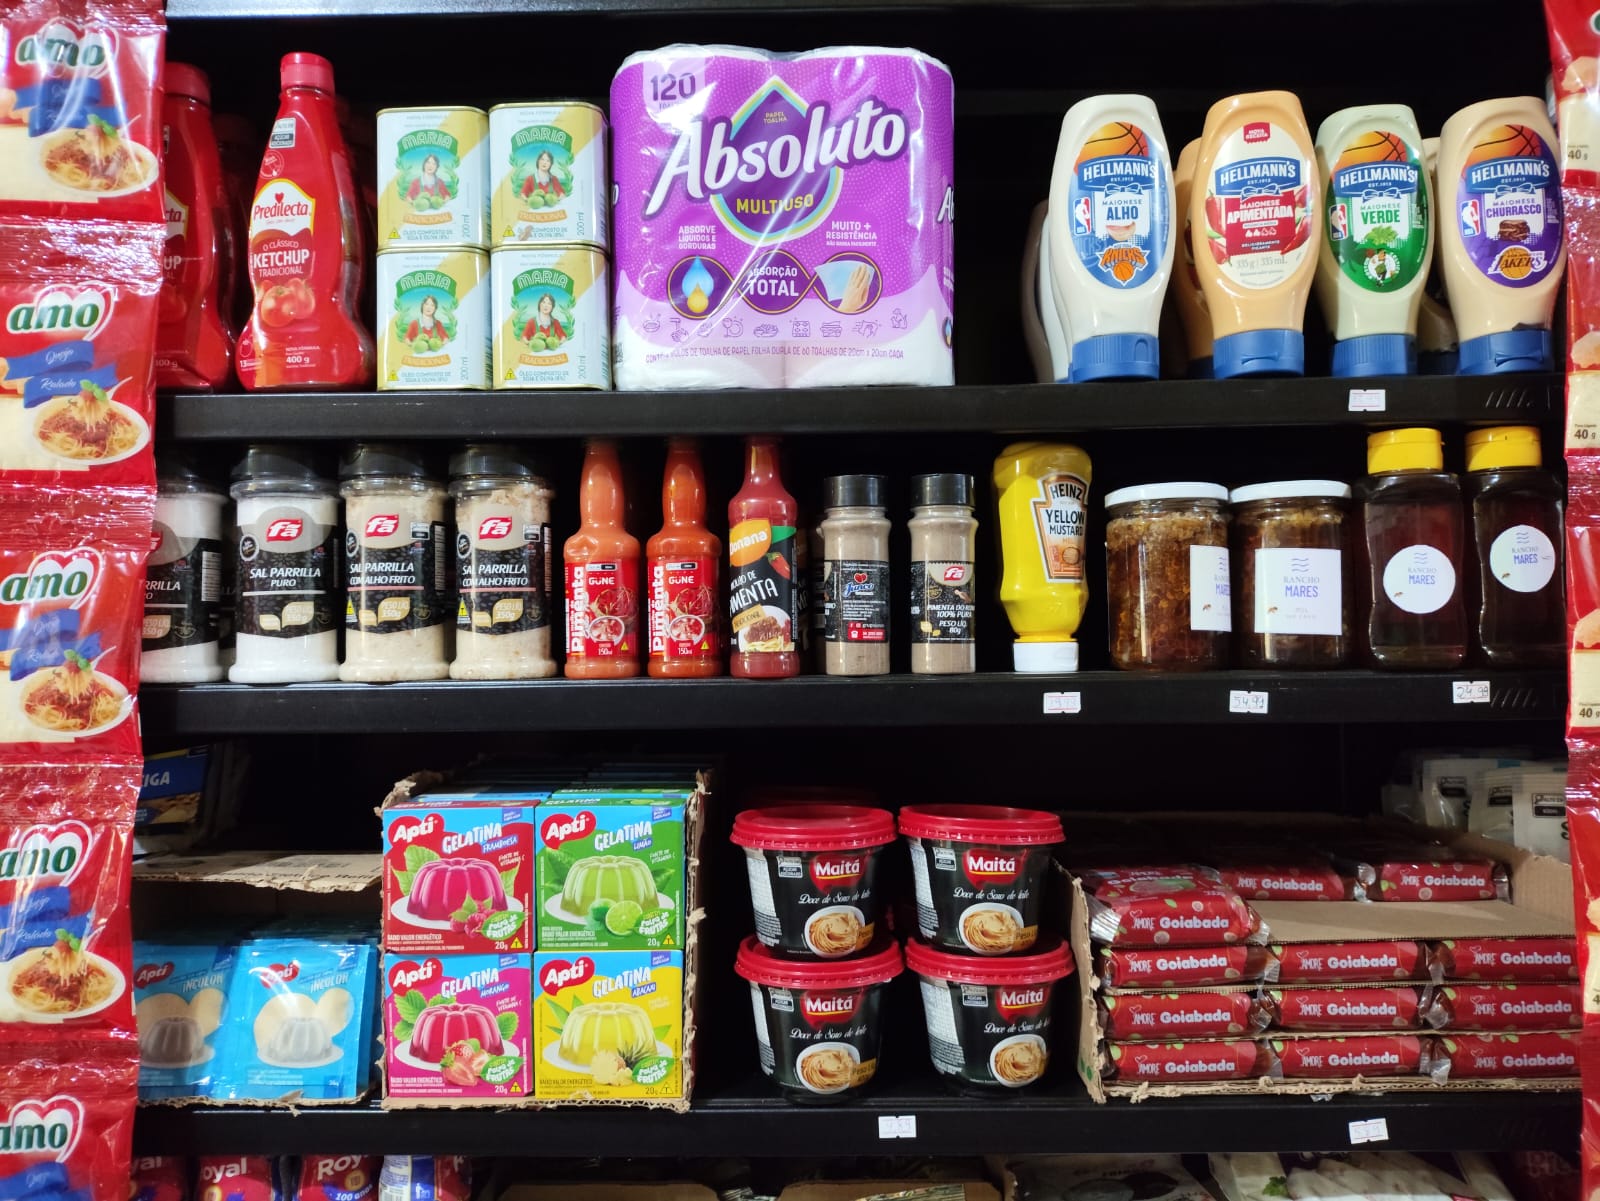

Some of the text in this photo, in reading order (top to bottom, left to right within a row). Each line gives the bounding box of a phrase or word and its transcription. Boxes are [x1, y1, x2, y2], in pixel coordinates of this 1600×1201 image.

[16, 35, 105, 67] amo
[650, 73, 696, 101] 120
[402, 132, 454, 150] MARIA
[517, 128, 566, 146] MARIA
[645, 97, 907, 216] Absoluto
[1567, 150, 1588, 161] 40 g
[1083, 161, 1156, 181] HELLMANN'S
[1220, 161, 1296, 186] HELLMANN'S
[1339, 167, 1416, 188] HELLMANN'S
[1471, 160, 1550, 184] HELLMANN'S
[736, 193, 815, 215] MULTIUSO
[1239, 200, 1280, 209] MAIONESE
[1360, 203, 1402, 211] MAIONESE
[1492, 198, 1536, 206] MAIONESE
[253, 200, 310, 220] Predilecta
[1106, 205, 1139, 220] ALHO
[1227, 205, 1294, 224] APIMENTADA
[1361, 209, 1401, 225] VERDE
[1486, 204, 1542, 218] CHURRASCO
[462, 224, 472, 238] 200
[576, 222, 585, 236] 200
[678, 225, 716, 235] ABSORVE
[831, 221, 862, 232] MUITO
[678, 234, 710, 243] LÍQUIDOS
[826, 230, 878, 241] RESISTÊNCIA
[269, 239, 300, 250] CLÁSSICO
[678, 242, 716, 250] GORDURAS
[252, 249, 311, 269] KETCHUP
[1100, 248, 1145, 263] KNICKS
[1488, 253, 1548, 274] LAKERS
[259, 266, 304, 277] TRADICIONAL
[400, 272, 451, 290] MARIA
[518, 271, 569, 289] MARIA
[748, 279, 799, 297] TOTAL
[11, 302, 100, 332] amo
[699, 346, 722, 356] TOALHA
[722, 347, 731, 356] DE
[731, 346, 750, 356] PAPEL
[751, 346, 771, 355] FOLHA
[771, 345, 792, 355] DUPLA
[792, 346, 800, 355] DE
[801, 346, 809, 355] 60
[811, 346, 839, 356] TOALHAS
[839, 347, 848, 356] DE
[888, 349, 904, 359] CADA
[286, 356, 310, 366] 400 g
[460, 367, 468, 380] 200
[578, 366, 586, 379] 200
[40, 377, 78, 392] Ralado
[1574, 429, 1596, 441] 40 g
[1050, 483, 1083, 500] HEINZ
[1045, 509, 1086, 525] YELLOW
[1049, 524, 1084, 536] MUSTARD
[1513, 553, 1538, 565] MARES
[249, 567, 321, 579] SAL PARRILLA
[349, 562, 415, 574] SAL PARRILLA
[477, 564, 527, 575] PARRILLA
[746, 570, 757, 580] DE
[1, 570, 88, 601] amo
[270, 579, 296, 587] PURO
[365, 575, 389, 585] ALHO
[388, 574, 416, 584] FRITO
[478, 577, 529, 586] ALHO FRITO
[1283, 576, 1320, 584] RANCHO
[1408, 574, 1436, 585] MARES
[1285, 585, 1319, 598] MARES
[571, 566, 585, 652] Pimenta
[652, 565, 666, 652] Pimenta
[1579, 708, 1593, 718] 40
[393, 816, 434, 843] Apti
[545, 814, 586, 840] Apti
[483, 836, 517, 853] FRAMBOESA
[815, 858, 860, 876] Maitá
[968, 855, 1016, 872] Maitá
[1261, 879, 1324, 892] Goiabada
[1423, 874, 1485, 887] Goiabada
[798, 891, 860, 904] Doce de de
[953, 886, 1016, 899] Doce de de
[1159, 915, 1229, 929] Goiabada
[495, 941, 508, 951] 20g
[1156, 955, 1228, 970] Goiabada
[1327, 954, 1397, 970] Goiabada
[1500, 951, 1572, 965] Goiabada
[136, 965, 168, 983] Apti
[393, 962, 433, 988] Apti
[544, 960, 585, 987] Apti
[480, 983, 509, 997] MORANGO
[632, 984, 656, 997] ABACAXI
[1001, 988, 1044, 1006] Maitá
[806, 995, 853, 1012] Maitá
[1326, 1001, 1397, 1016] Goiabada
[1501, 1000, 1572, 1015] Goiabada
[1159, 1009, 1231, 1024] Goiabada
[789, 1027, 854, 1040] Doce de de
[984, 1022, 1017, 1033] Doce de
[1328, 1051, 1400, 1067] Goiabada
[1502, 1053, 1575, 1068] Goiabada
[1165, 1060, 1236, 1074] Goiabada
[494, 1085, 508, 1095] 20g
[202, 1157, 248, 1183] oyal
[336, 1193, 353, 1201] 100
